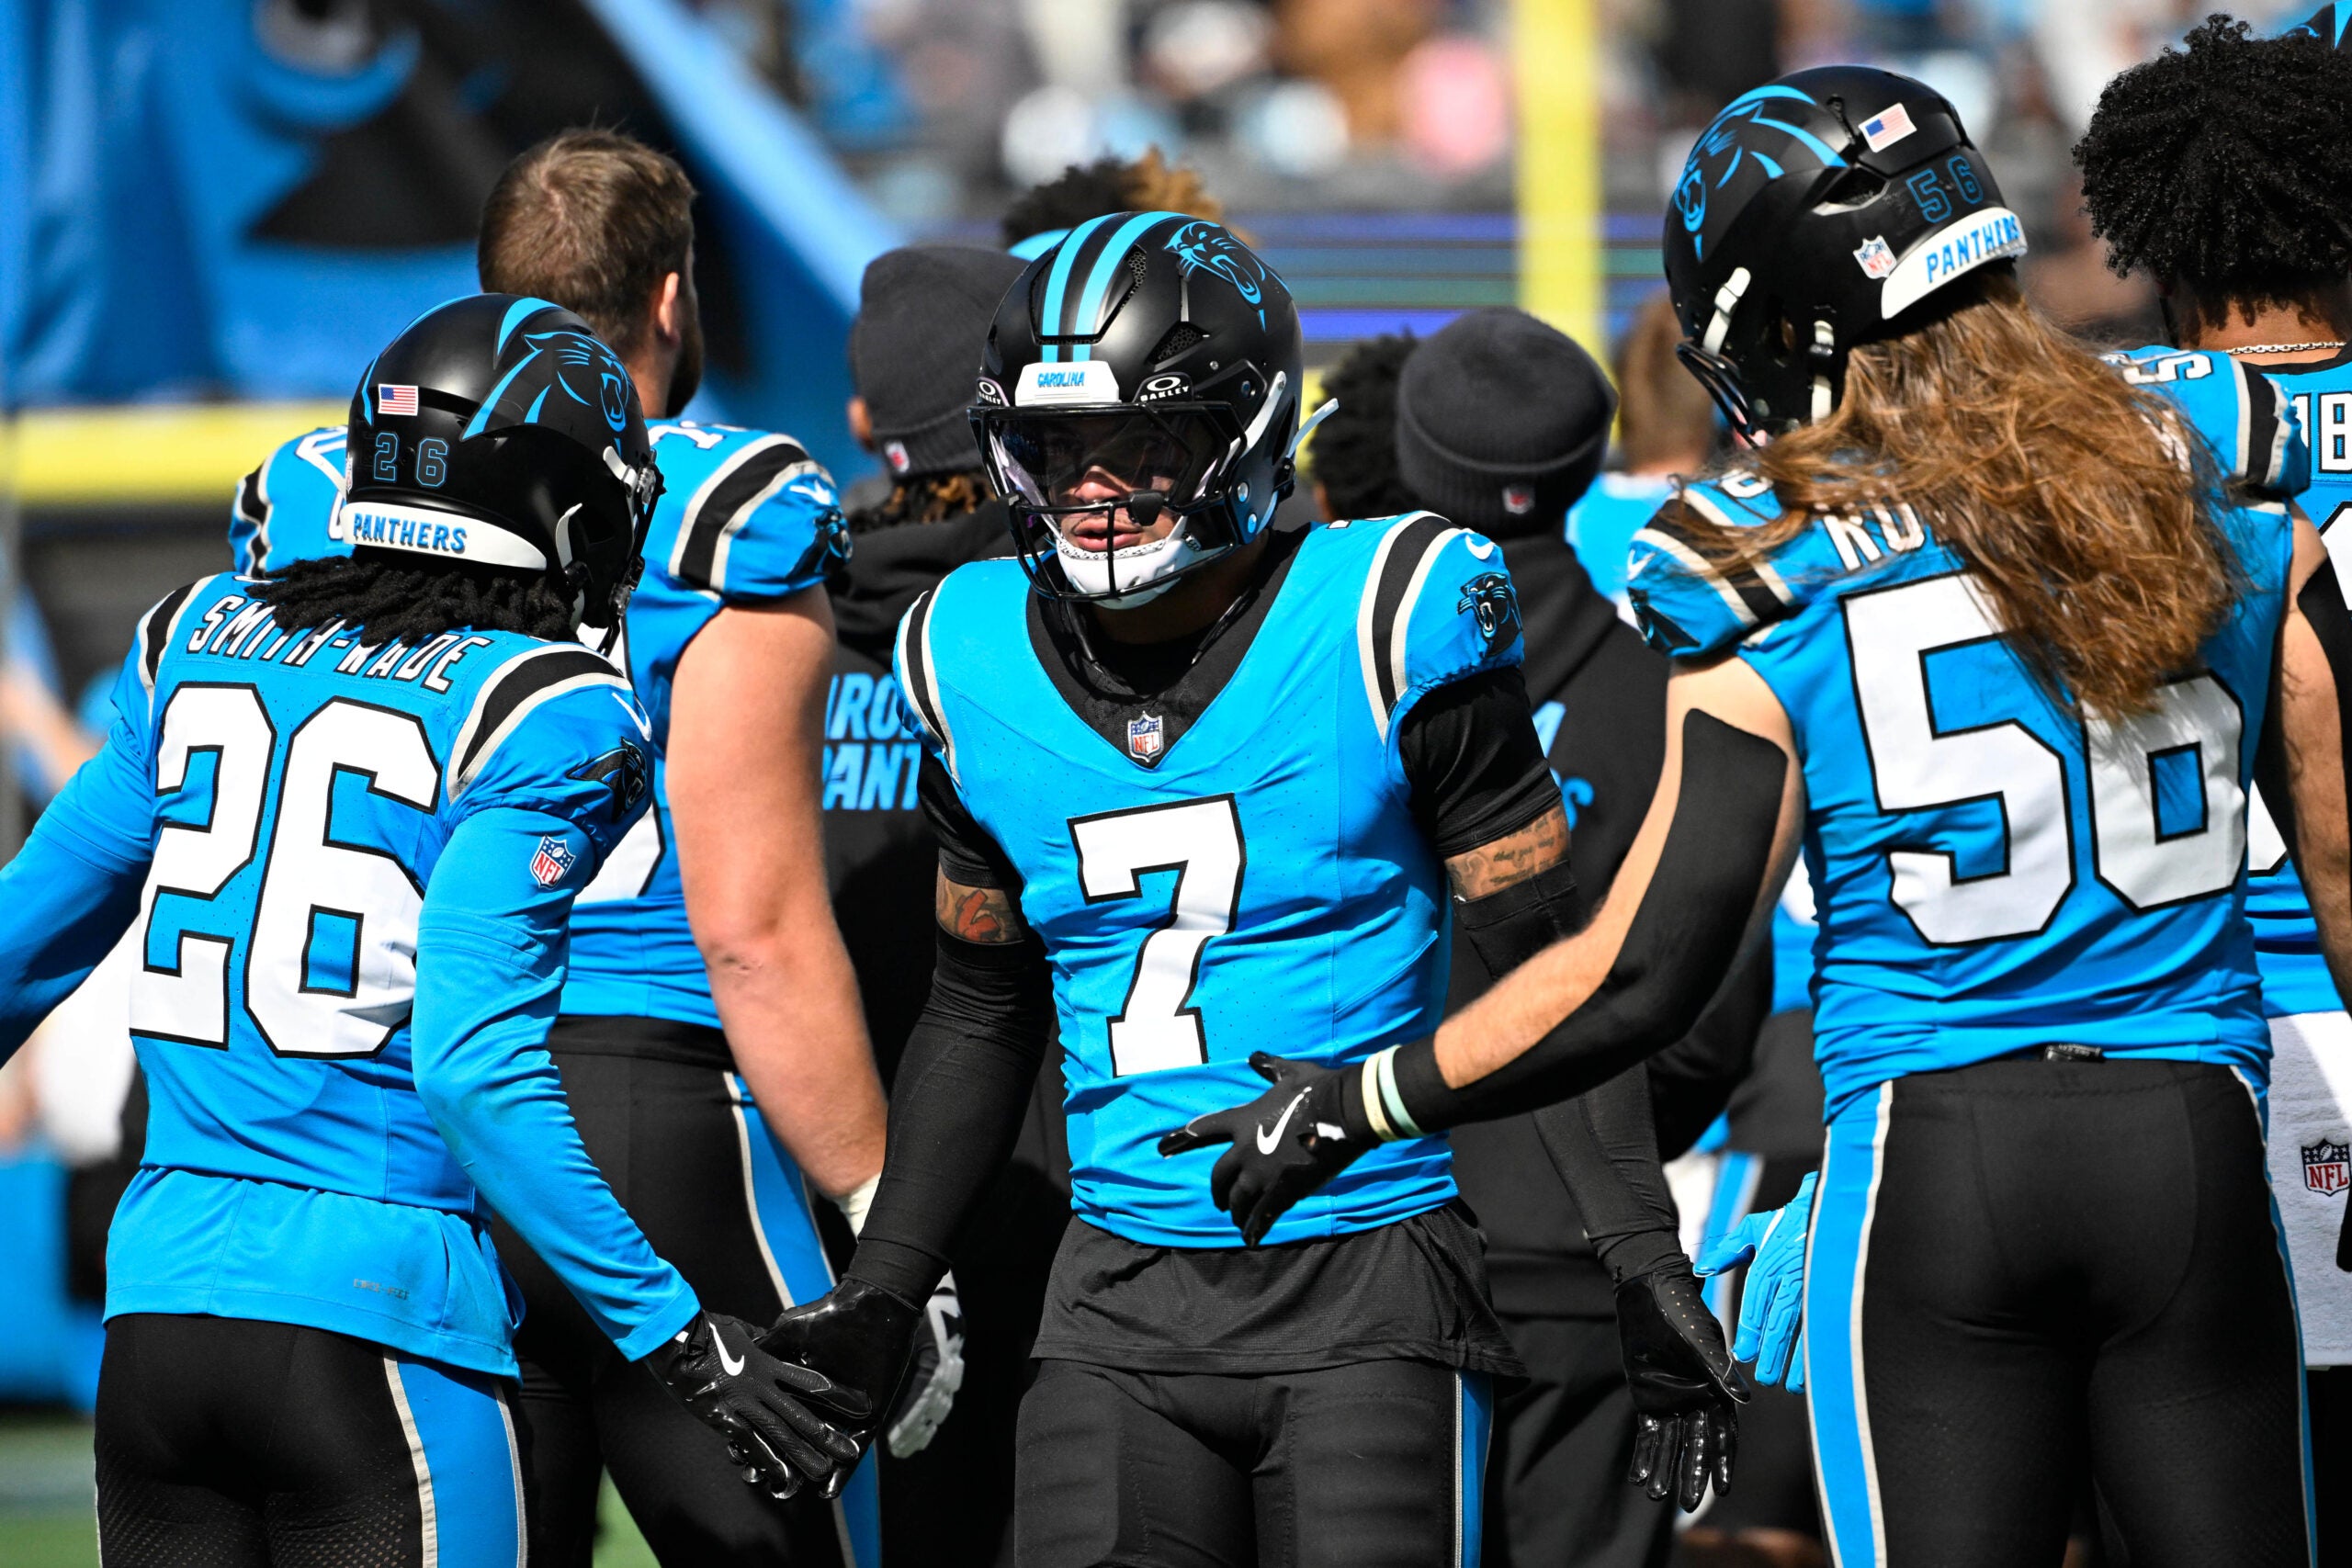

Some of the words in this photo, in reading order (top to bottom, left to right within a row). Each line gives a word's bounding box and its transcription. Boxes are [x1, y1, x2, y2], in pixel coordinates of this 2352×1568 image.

[1905, 155, 1984, 223] 56
[1927, 215, 2020, 283] PANTHERS
[1037, 371, 1085, 388] CAROLINA
[1140, 385, 1189, 401] OAKLEY
[374, 432, 448, 488] 26
[353, 513, 468, 554] PANTHERS
[824, 672, 917, 740] RO
[1133, 734, 1159, 754] NFL
[1839, 570, 2247, 949] 56
[822, 742, 922, 811] ANT
[129, 681, 442, 1059] 26
[533, 852, 562, 886] NFL
[1066, 793, 1247, 1078] 7
[2308, 1163, 2349, 1191] NFL
